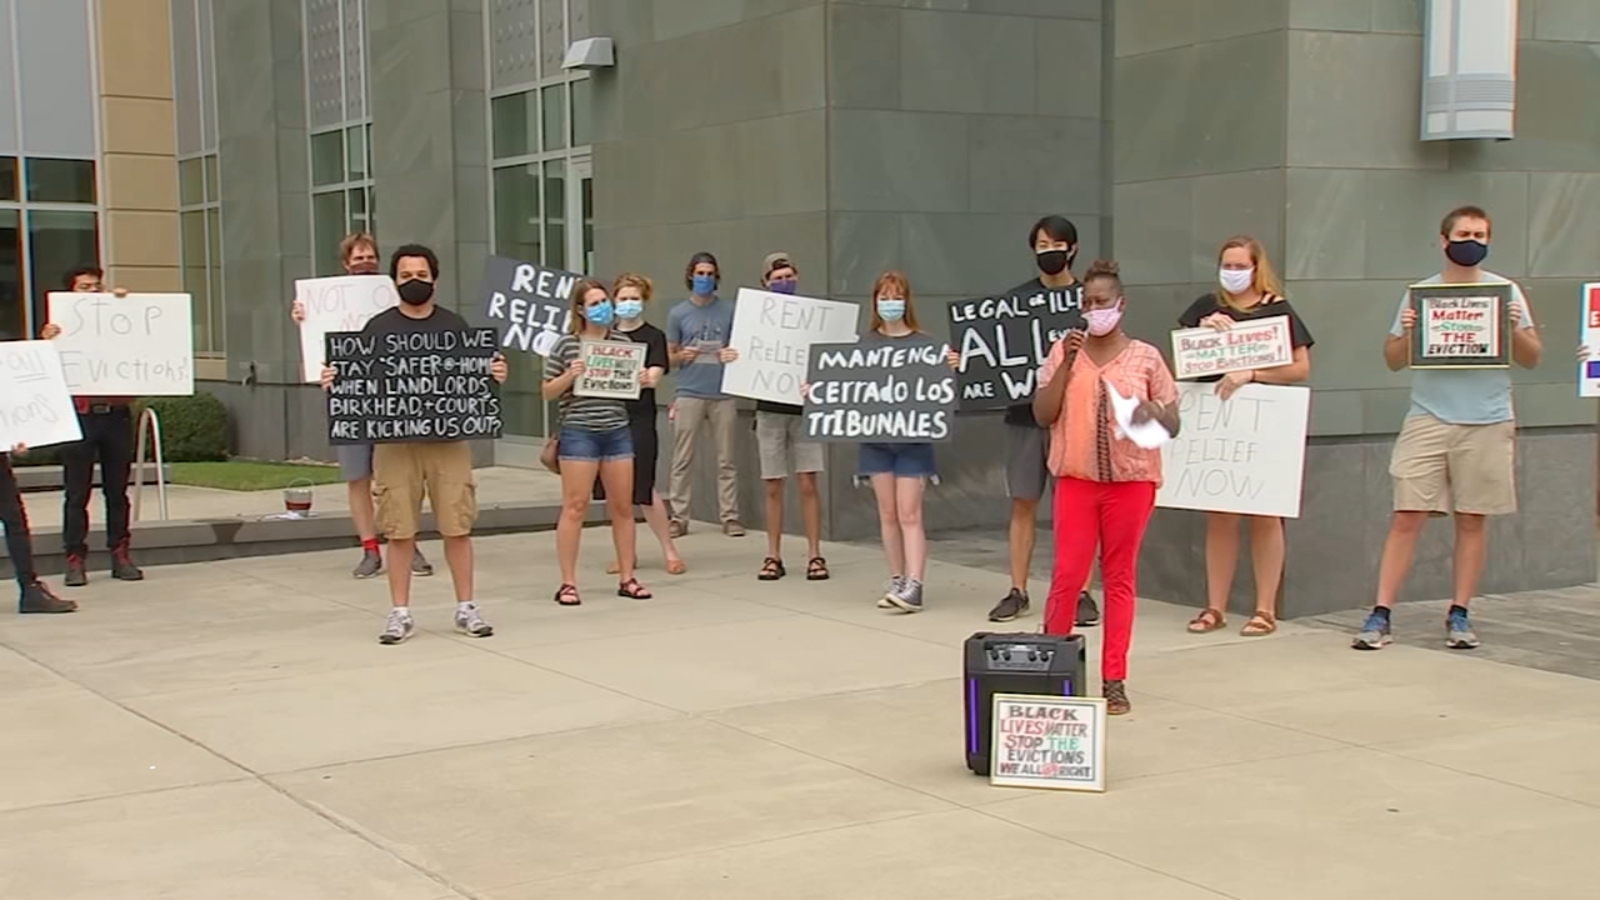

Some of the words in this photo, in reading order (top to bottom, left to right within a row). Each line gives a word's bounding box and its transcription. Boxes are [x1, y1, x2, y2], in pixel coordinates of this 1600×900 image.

[511, 263, 575, 299] REN
[306, 284, 355, 315] NOT
[371, 284, 392, 309] O
[951, 296, 1029, 322] LEGAL
[68, 297, 163, 337] STOP
[760, 296, 834, 333] RENT
[1431, 310, 1484, 320] Matter
[330, 336, 376, 357] HOW
[385, 331, 456, 354] SHOULD
[461, 330, 495, 348] WE
[959, 318, 1047, 373] ALL
[1440, 332, 1476, 343] THE
[748, 335, 806, 366] RELIE
[331, 359, 376, 377] STAY
[330, 379, 379, 396] WHEN
[385, 376, 492, 399] LANDLORDS,
[915, 377, 954, 404] LOS
[963, 382, 995, 399] ARE
[331, 421, 360, 439] ARE
[367, 418, 431, 438] KICKING
[435, 416, 460, 437] US
[462, 415, 502, 437] OUT?
[1174, 467, 1266, 499] NOW
[1009, 705, 1079, 720] BLACK
[1000, 719, 1044, 735] LIVES
[1004, 734, 1043, 749] STOP
[1047, 736, 1080, 750] THE
[1000, 762, 1020, 774] WE
[1020, 763, 1041, 775] ALL
[1008, 749, 1085, 764] EVICTIONS
